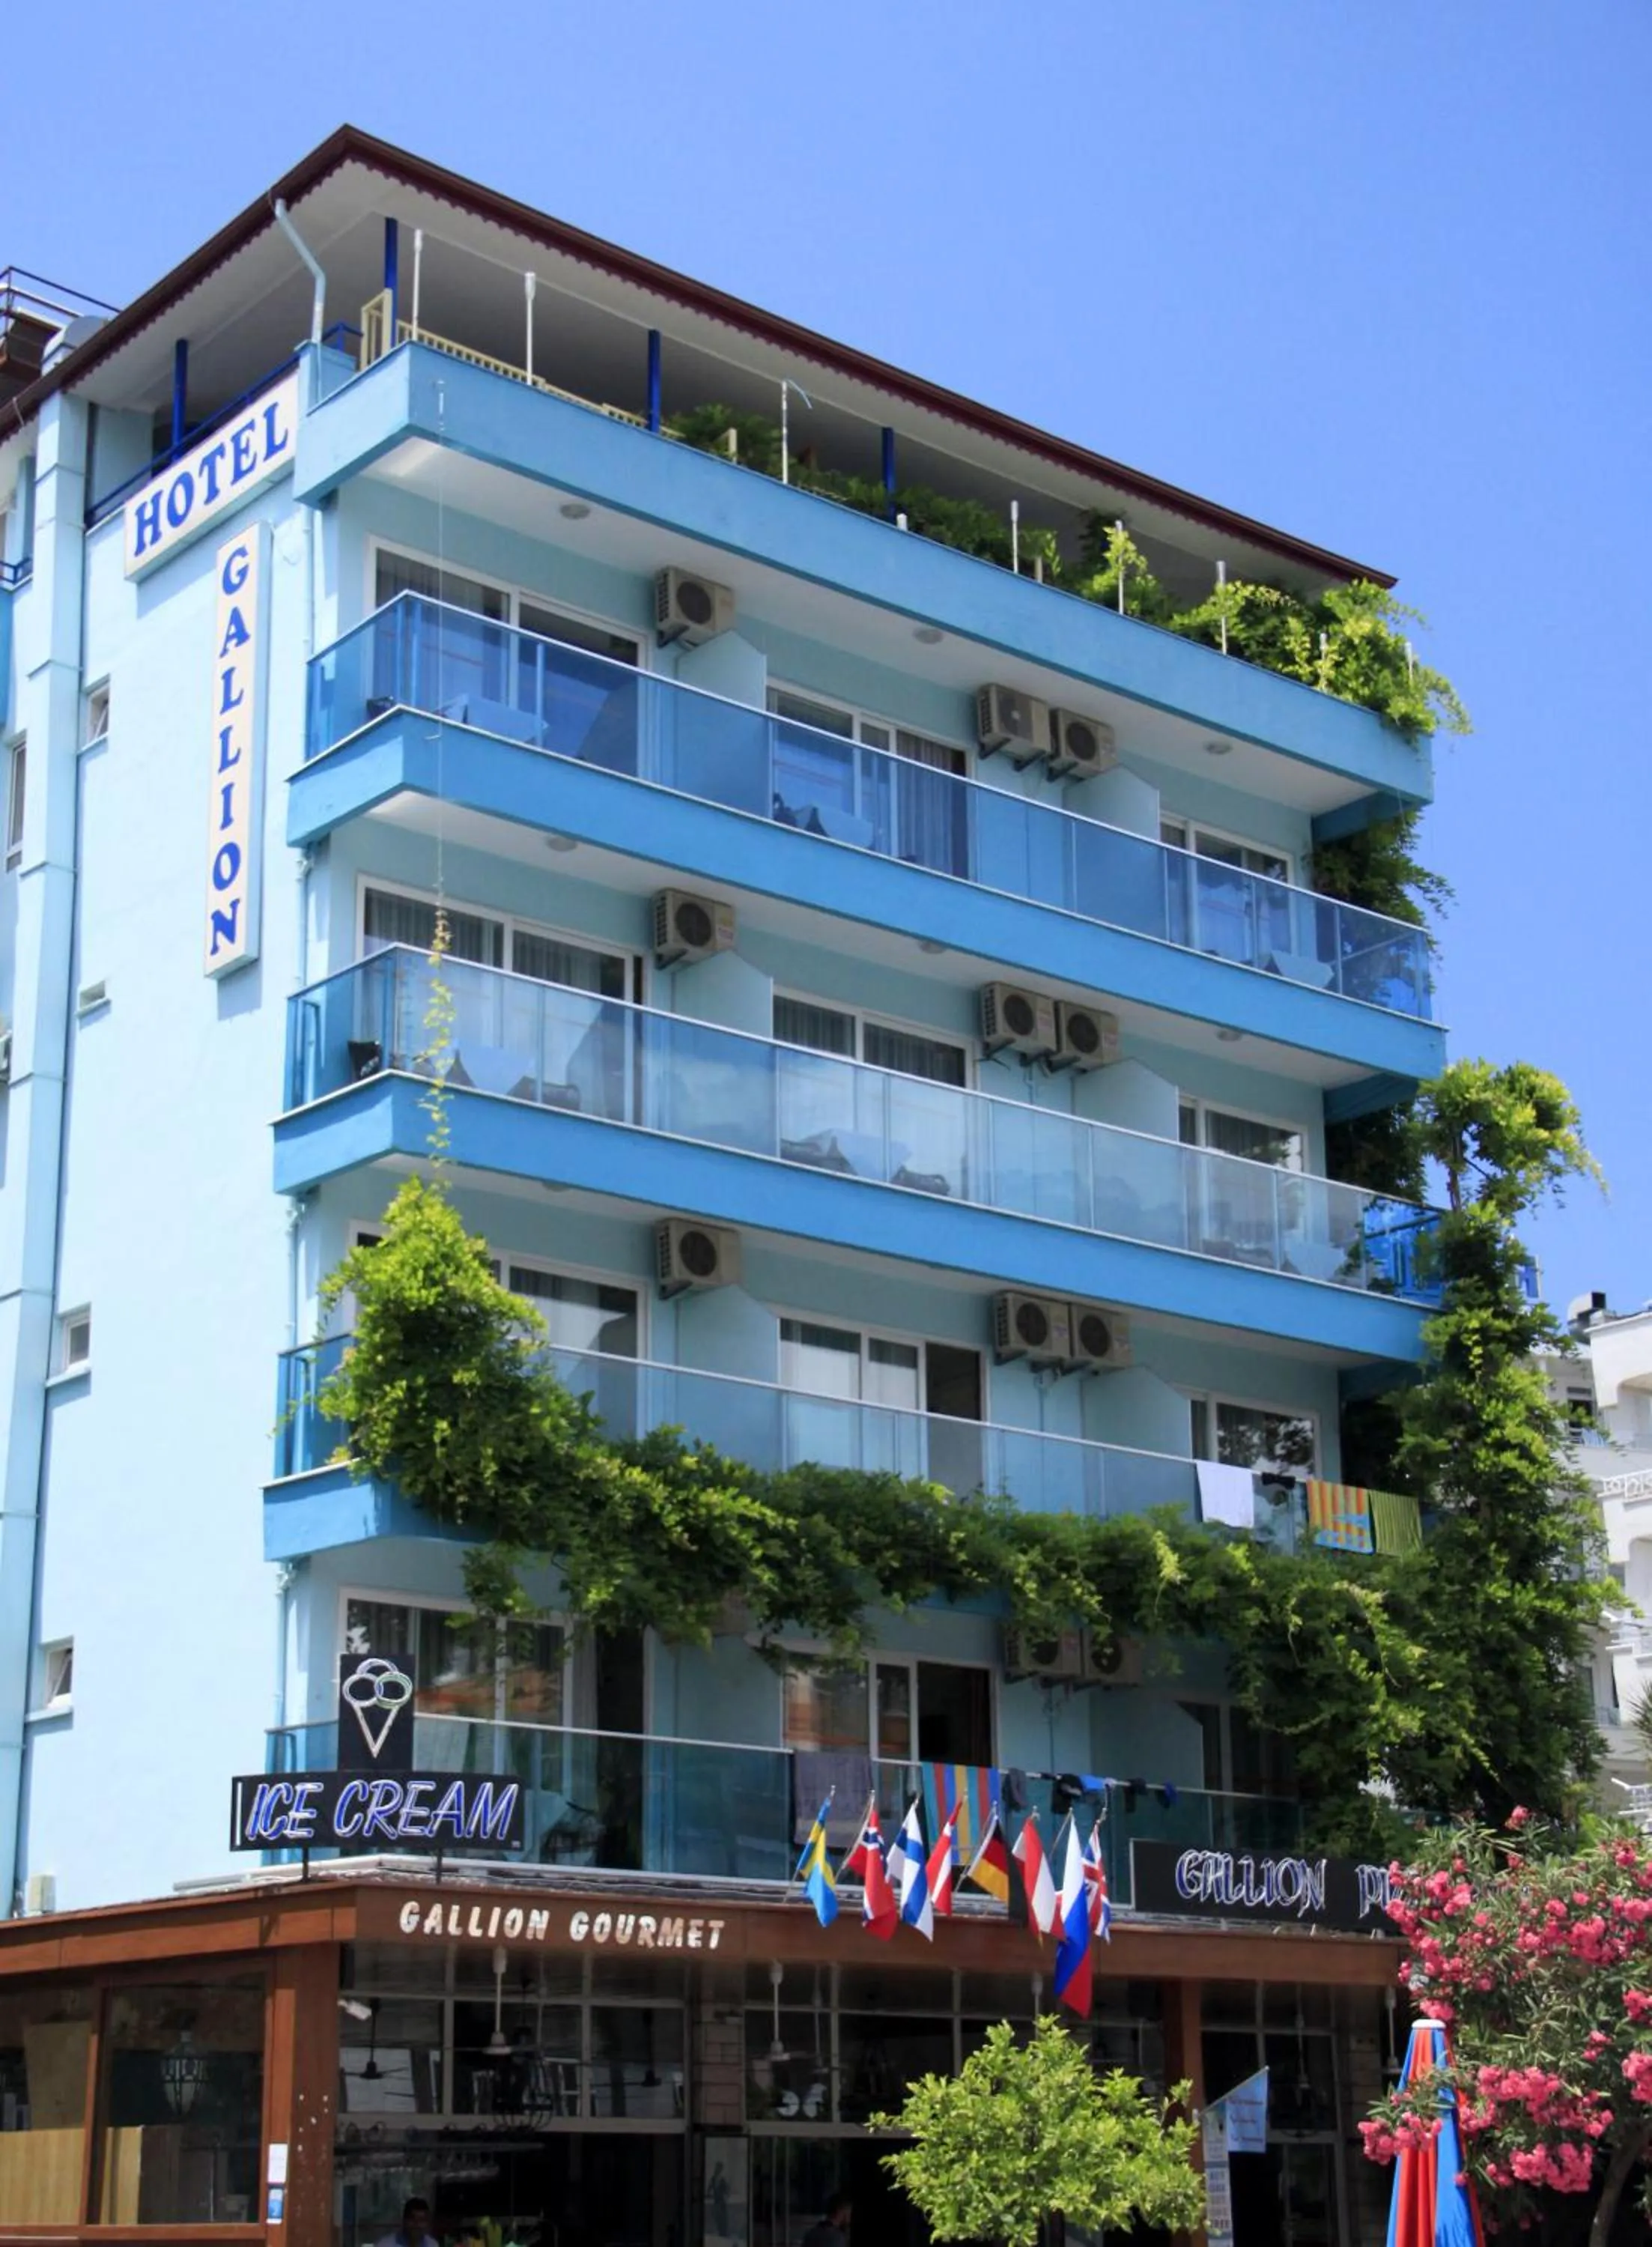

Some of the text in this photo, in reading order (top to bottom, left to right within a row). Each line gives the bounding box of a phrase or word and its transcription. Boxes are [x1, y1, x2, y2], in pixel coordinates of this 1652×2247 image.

[133, 401, 290, 557] HOTEL
[209, 545, 251, 956] GALLION
[245, 1778, 520, 1841] ICE CREAM
[1174, 1849, 1328, 1918] GALLION
[398, 1900, 726, 1950] GALLION GOURMET
